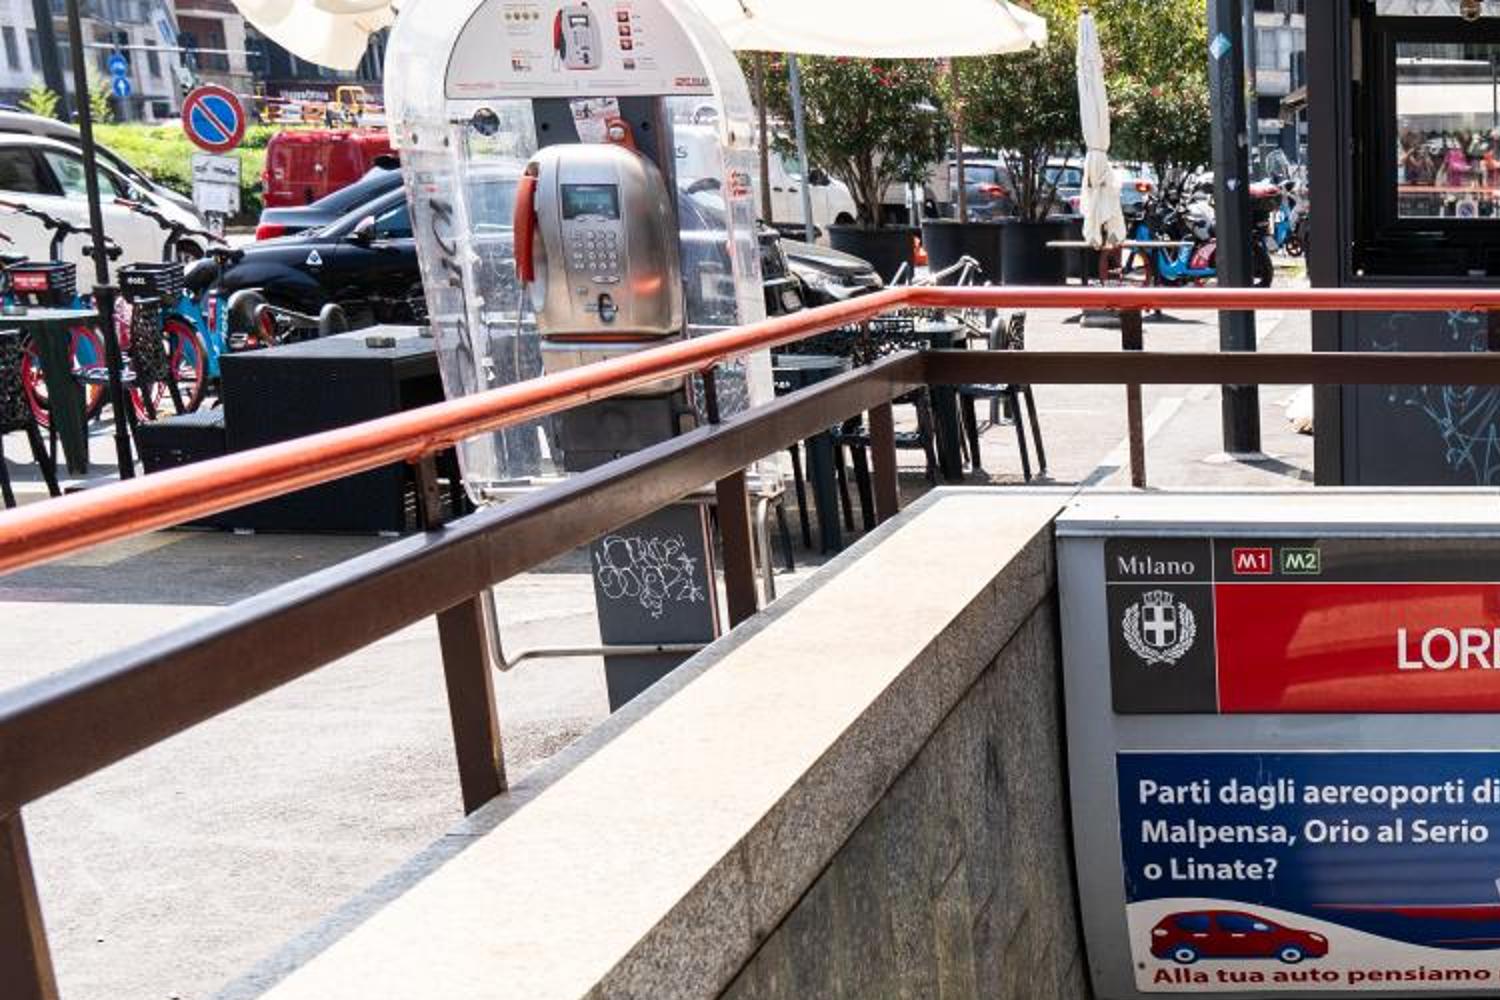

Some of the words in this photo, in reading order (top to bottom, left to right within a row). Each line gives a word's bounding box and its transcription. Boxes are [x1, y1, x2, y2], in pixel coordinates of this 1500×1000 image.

[1117, 556, 1196, 576] Milano
[1237, 553, 1267, 569] M1
[1285, 553, 1317, 569] M2
[1138, 778, 1212, 804] Parti
[1218, 777, 1295, 811] dagli
[1303, 778, 1465, 811] aereoporti
[1139, 818, 1297, 849] Malpensa,
[1304, 818, 1370, 845] Orio
[1376, 818, 1404, 844] al
[1410, 818, 1490, 845] Serio
[1143, 861, 1163, 881] o
[1170, 856, 1278, 882] Linate?
[1152, 966, 1212, 984] Alla
[1215, 968, 1265, 983] tua
[1272, 967, 1340, 983] auto
[1347, 965, 1491, 985] pensiamo
